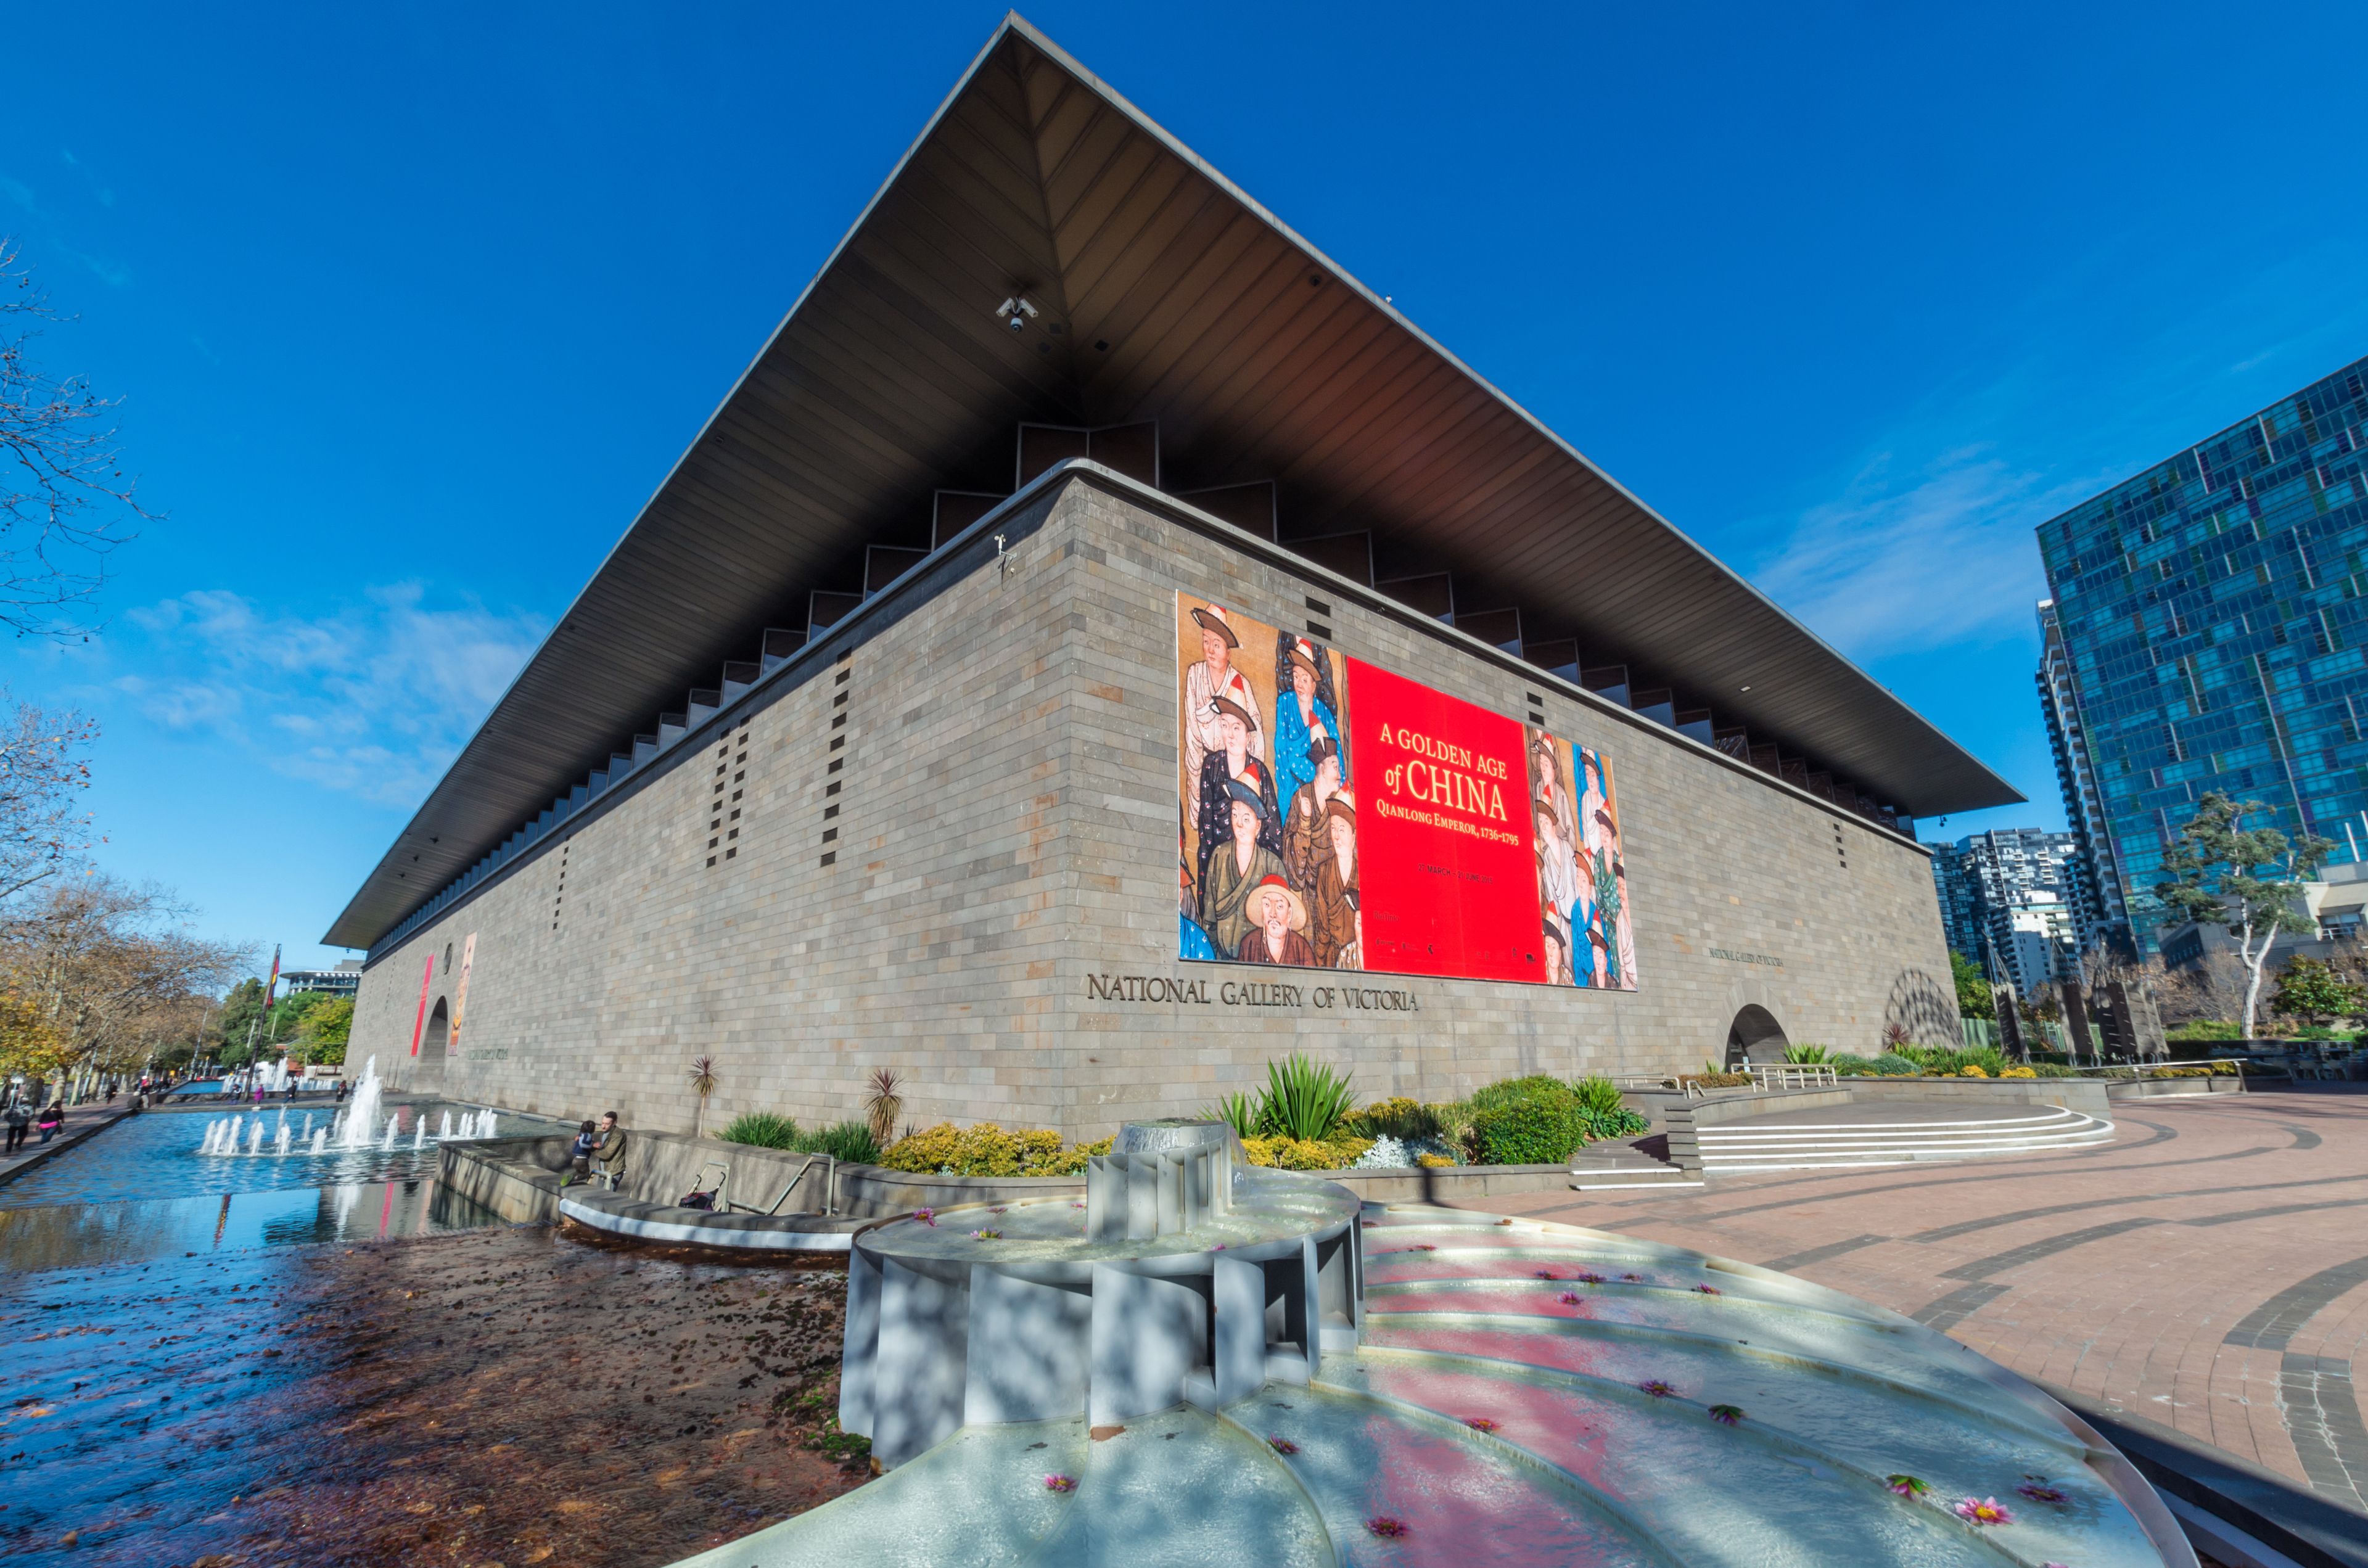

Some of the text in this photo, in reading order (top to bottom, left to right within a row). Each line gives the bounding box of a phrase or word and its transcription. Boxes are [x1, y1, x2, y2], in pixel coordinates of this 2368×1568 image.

[1380, 723, 1507, 780] A GOLDEN AGE
[1385, 760, 1508, 821] of CHINA
[1376, 799, 1433, 825] QIANLONG
[1434, 813, 1479, 839] EMPEROR,
[1427, 865, 1450, 876] MARCH
[1466, 873, 1479, 882] JUNE
[1087, 974, 1419, 1011] NATIONAL GALLERY OF VICTORIA
